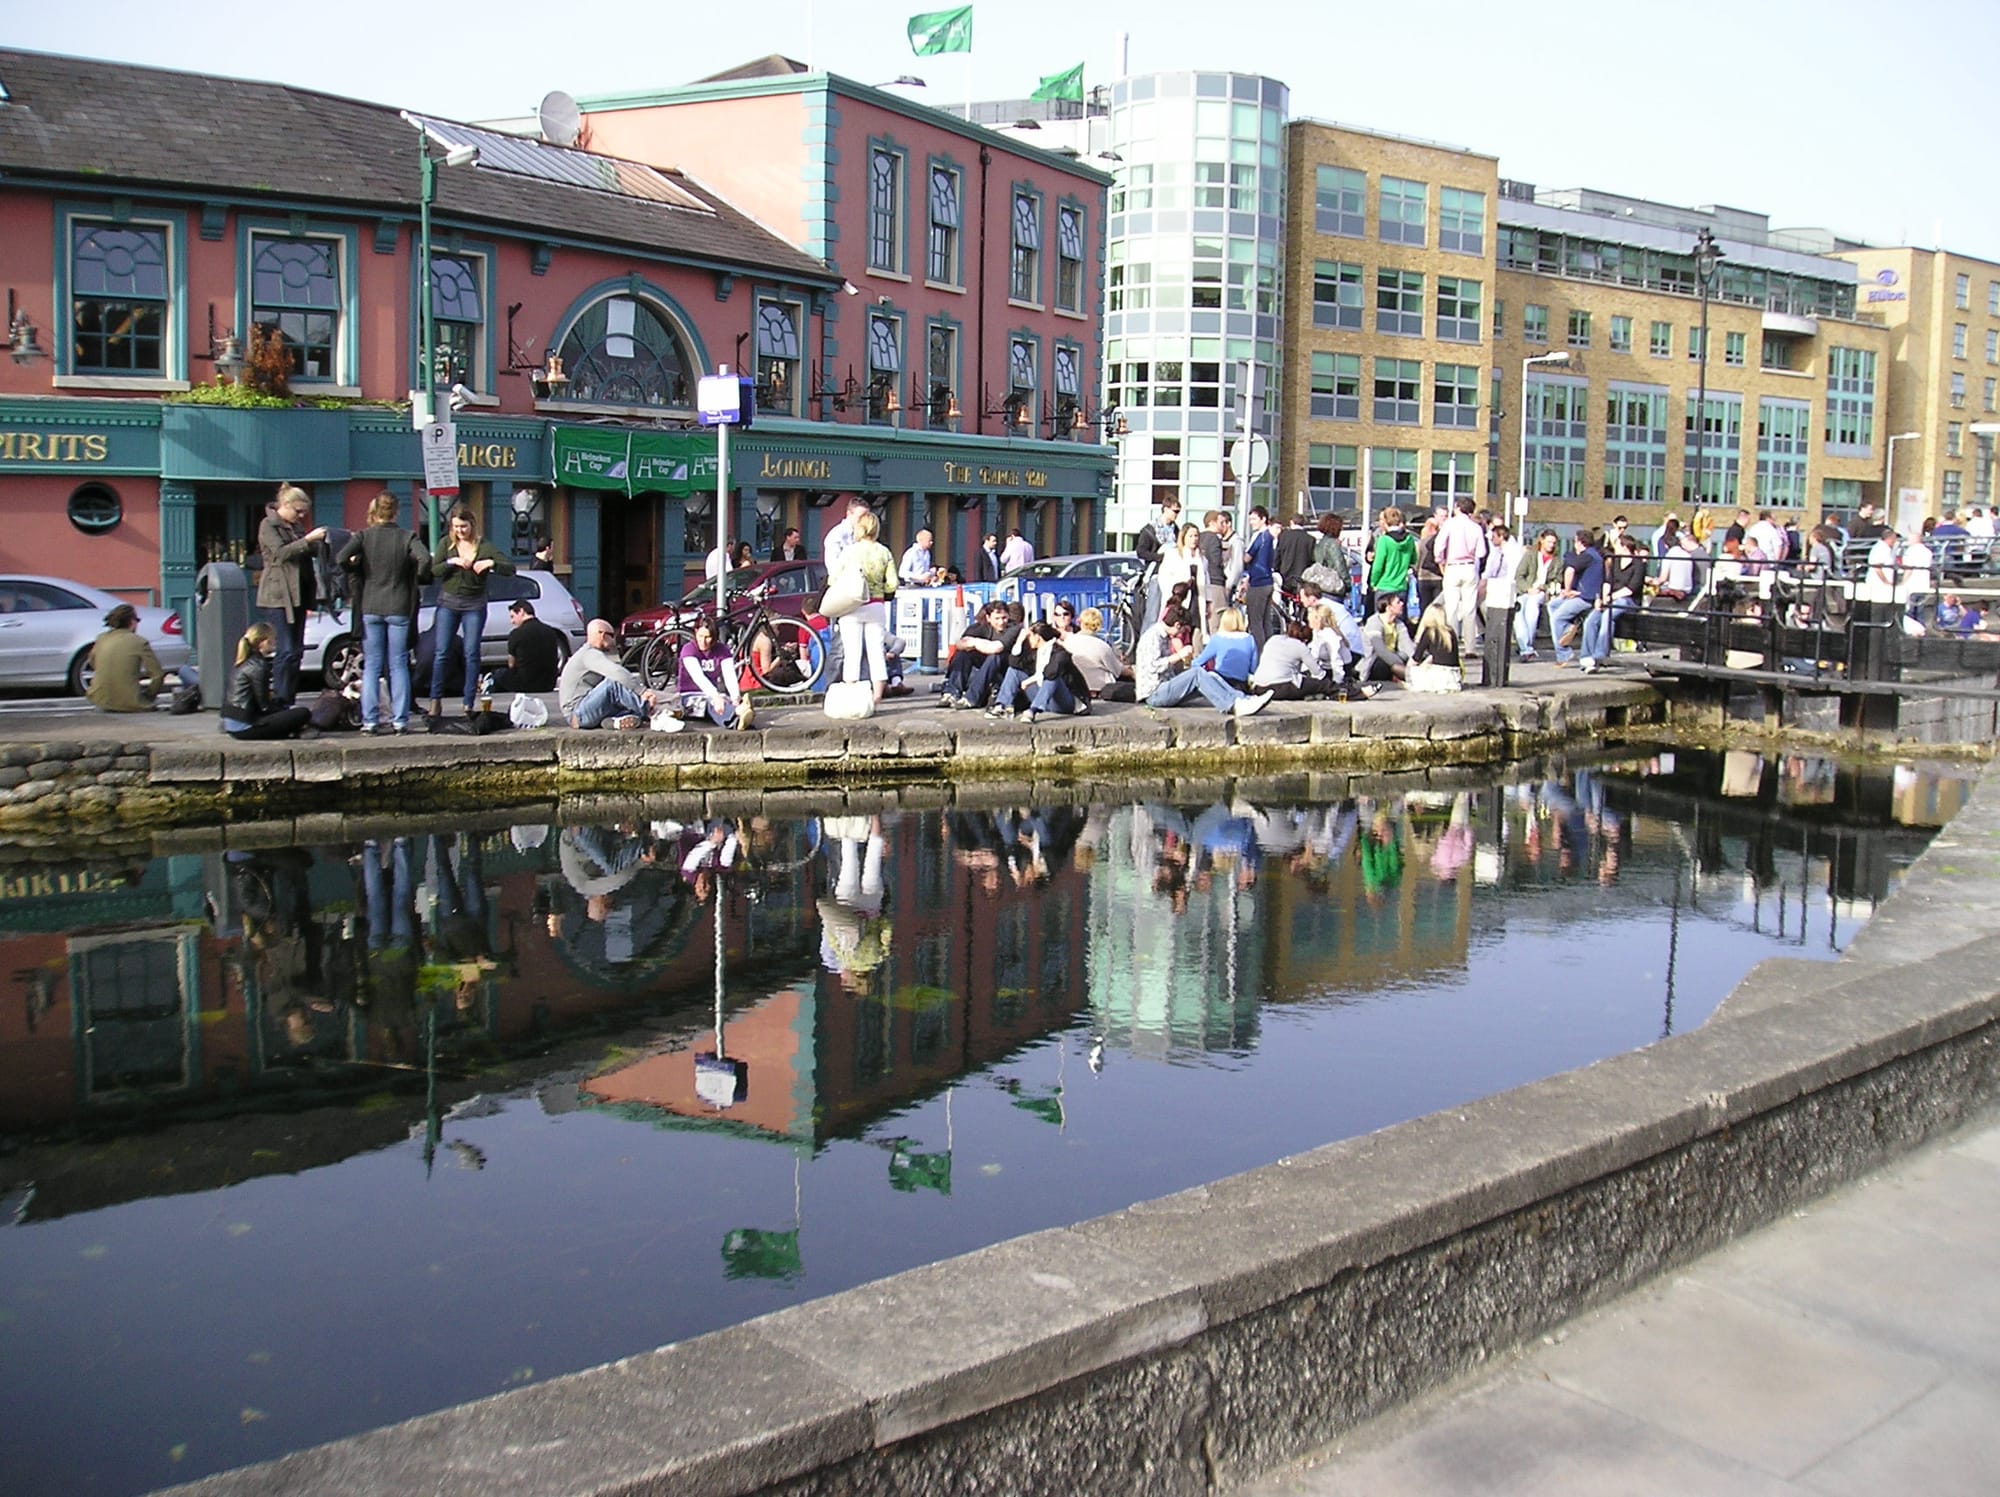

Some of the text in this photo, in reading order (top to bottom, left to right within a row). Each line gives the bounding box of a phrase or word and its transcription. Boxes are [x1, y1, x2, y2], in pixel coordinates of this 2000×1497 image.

[435, 428, 444, 443] P
[0, 432, 107, 461] IRITS
[457, 443, 516, 468] ARGE
[589, 461, 602, 471] Cup
